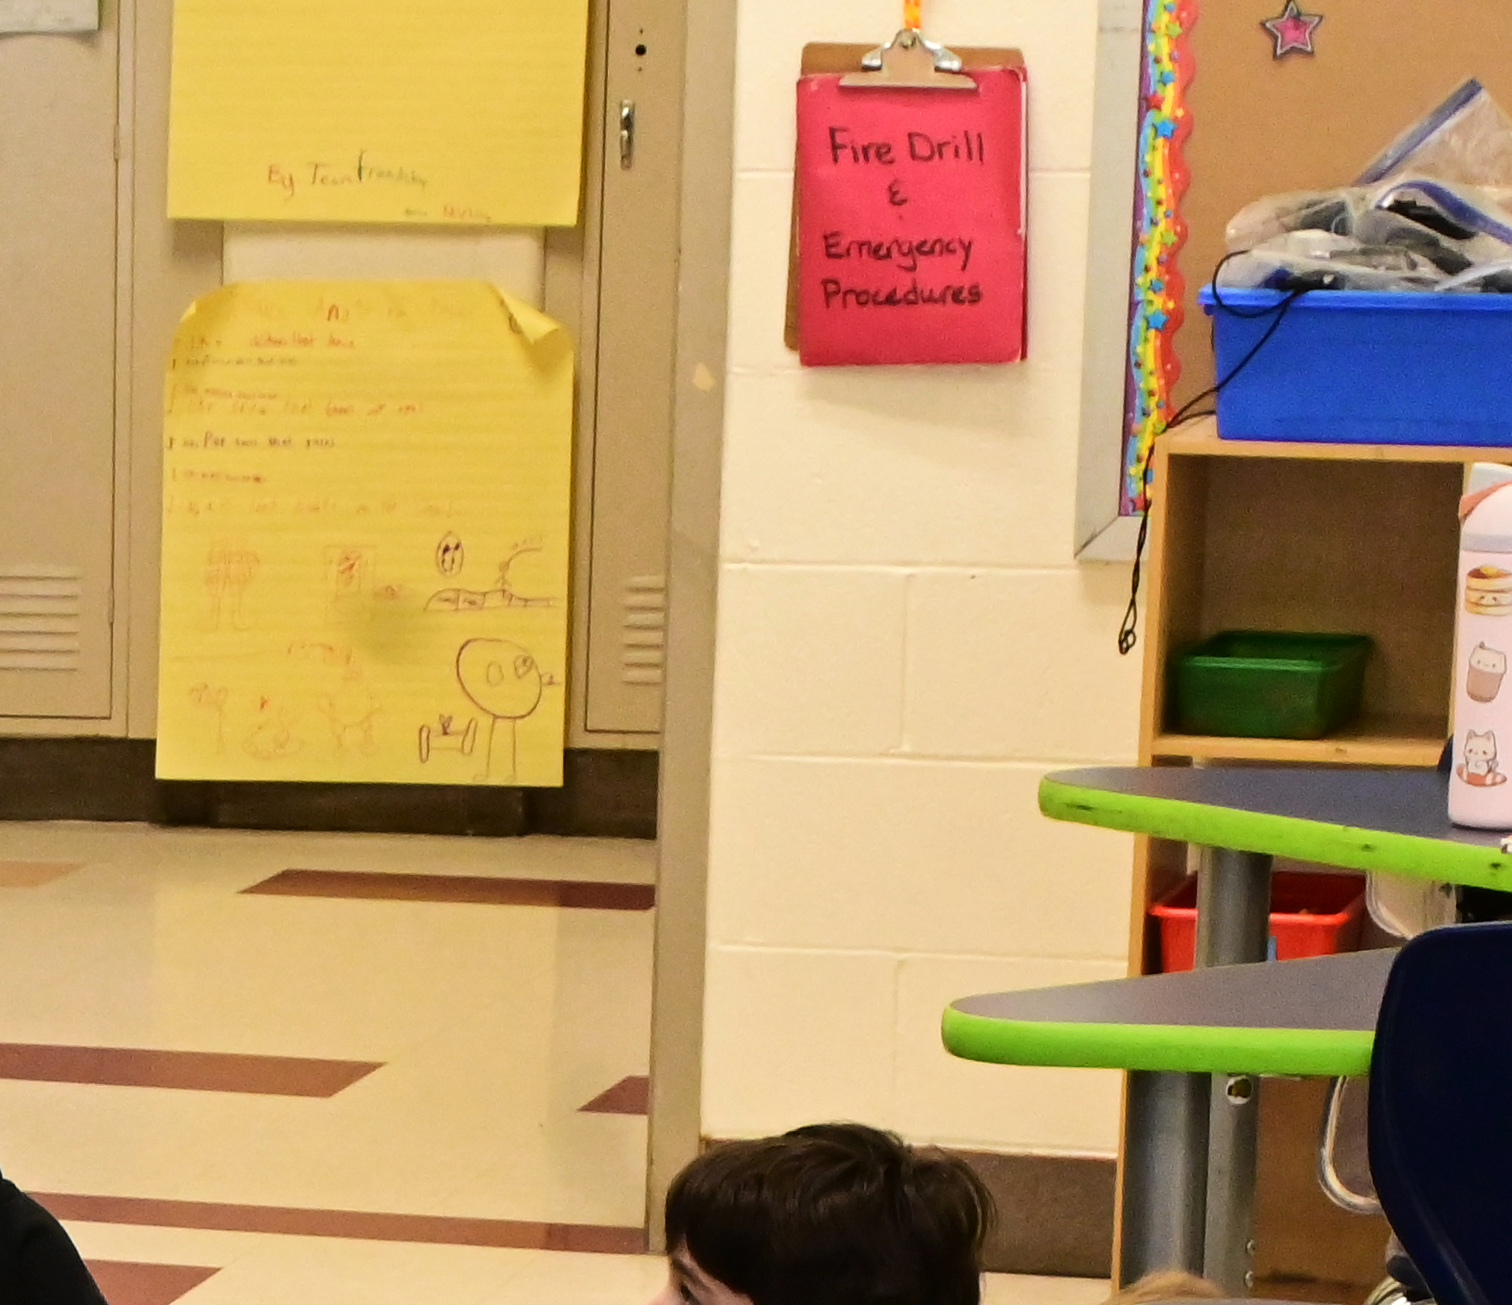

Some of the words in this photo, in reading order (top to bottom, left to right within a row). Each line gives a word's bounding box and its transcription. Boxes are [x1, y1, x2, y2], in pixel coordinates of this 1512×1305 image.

[829, 127, 896, 166] Fire
[907, 129, 985, 166] Drill
[822, 231, 974, 273] Emergency
[821, 278, 984, 311] Procedures
